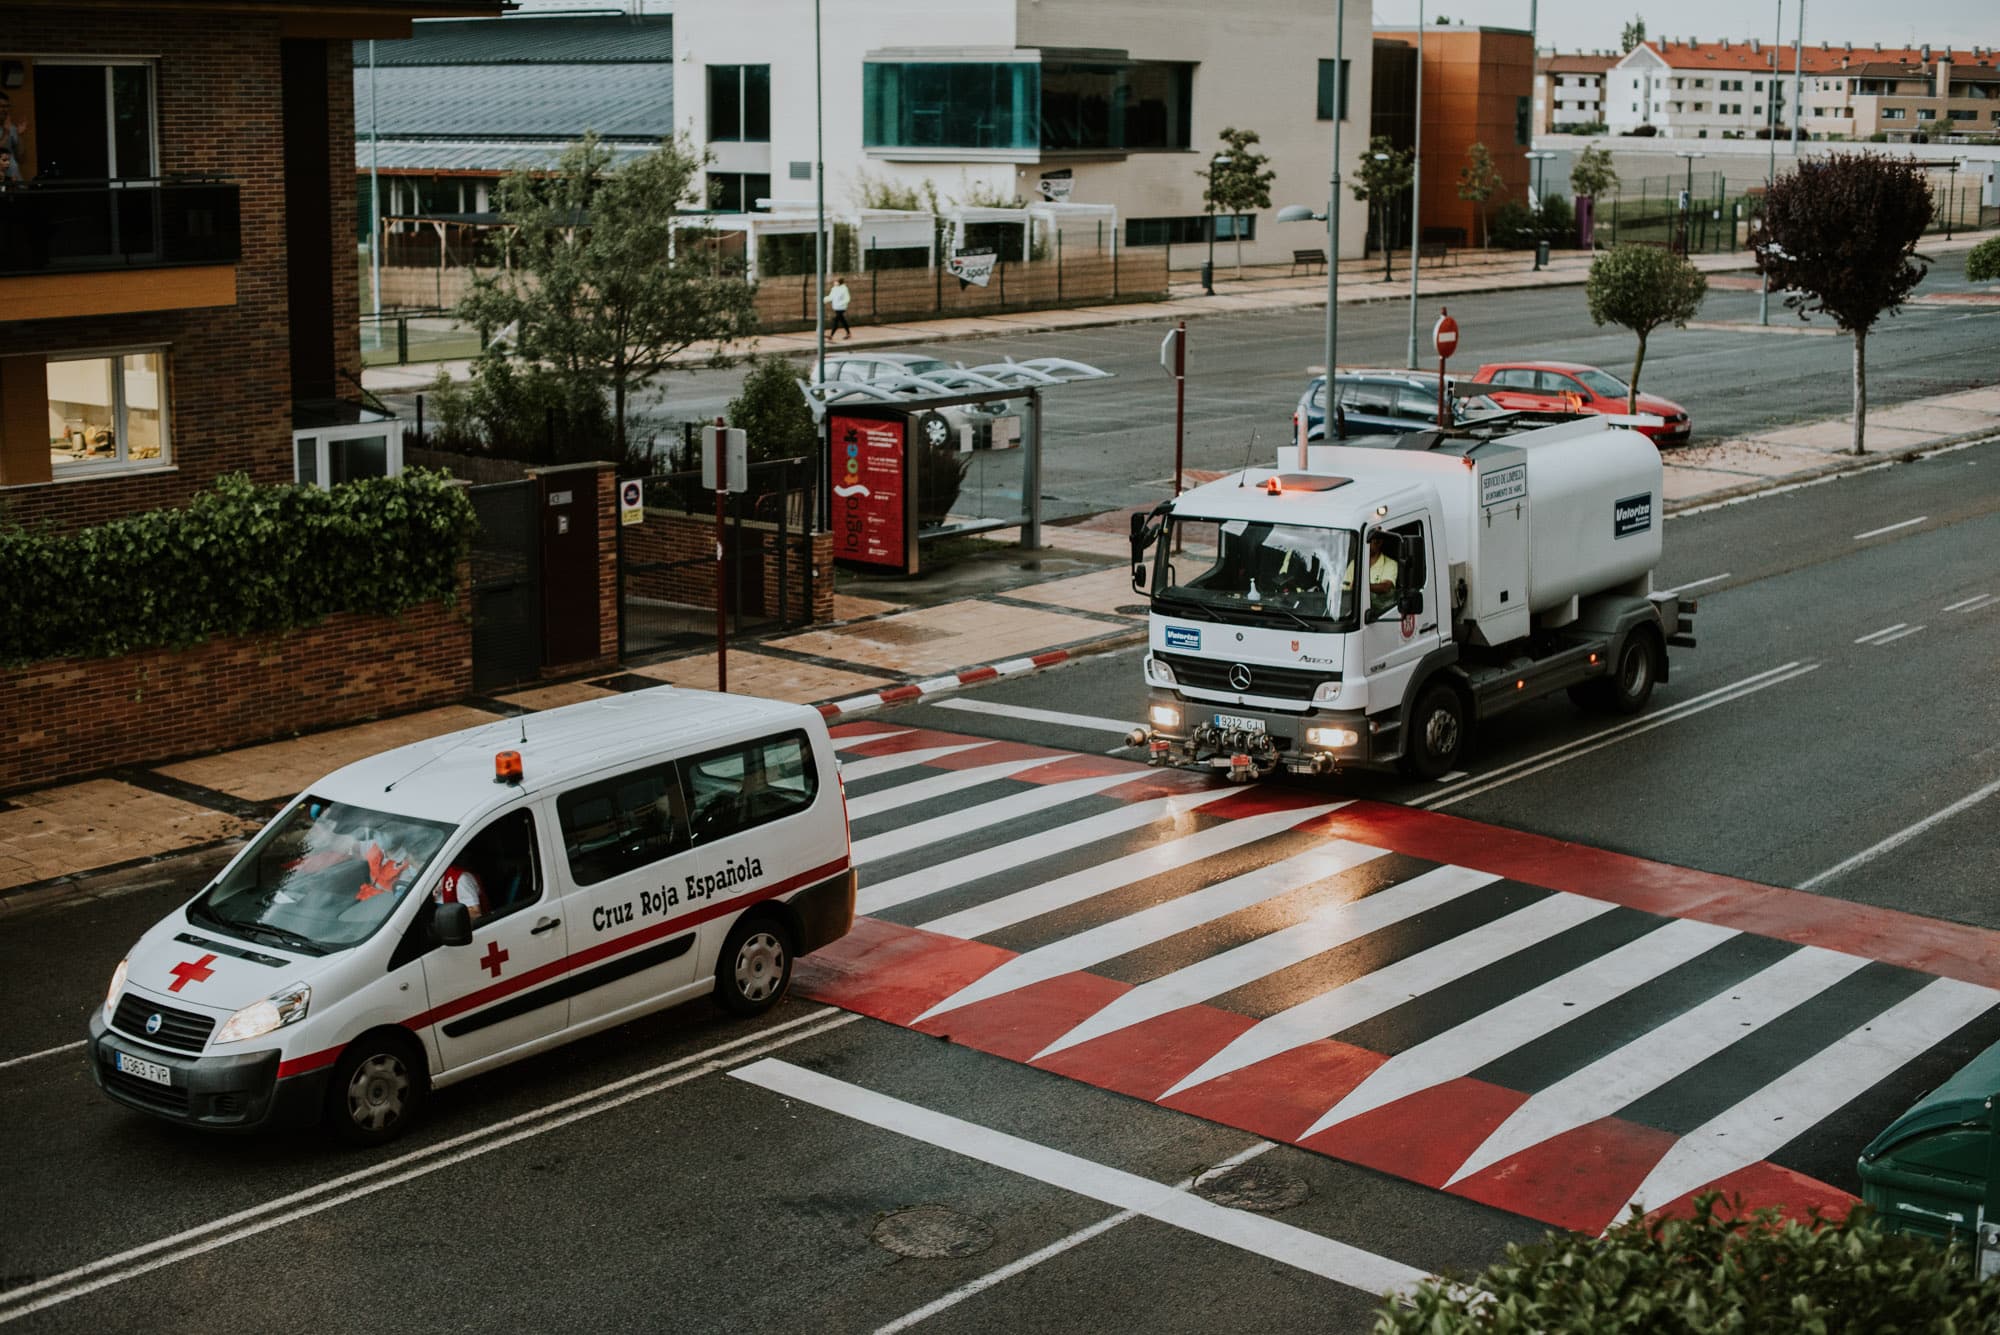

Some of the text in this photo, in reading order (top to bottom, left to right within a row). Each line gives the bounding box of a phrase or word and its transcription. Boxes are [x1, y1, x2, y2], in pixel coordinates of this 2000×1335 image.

[966, 266, 990, 279] sport
[1616, 504, 1650, 522] Valoriza
[1167, 630, 1199, 641] Valoriza
[593, 856, 764, 931] Cruz Roja Española
